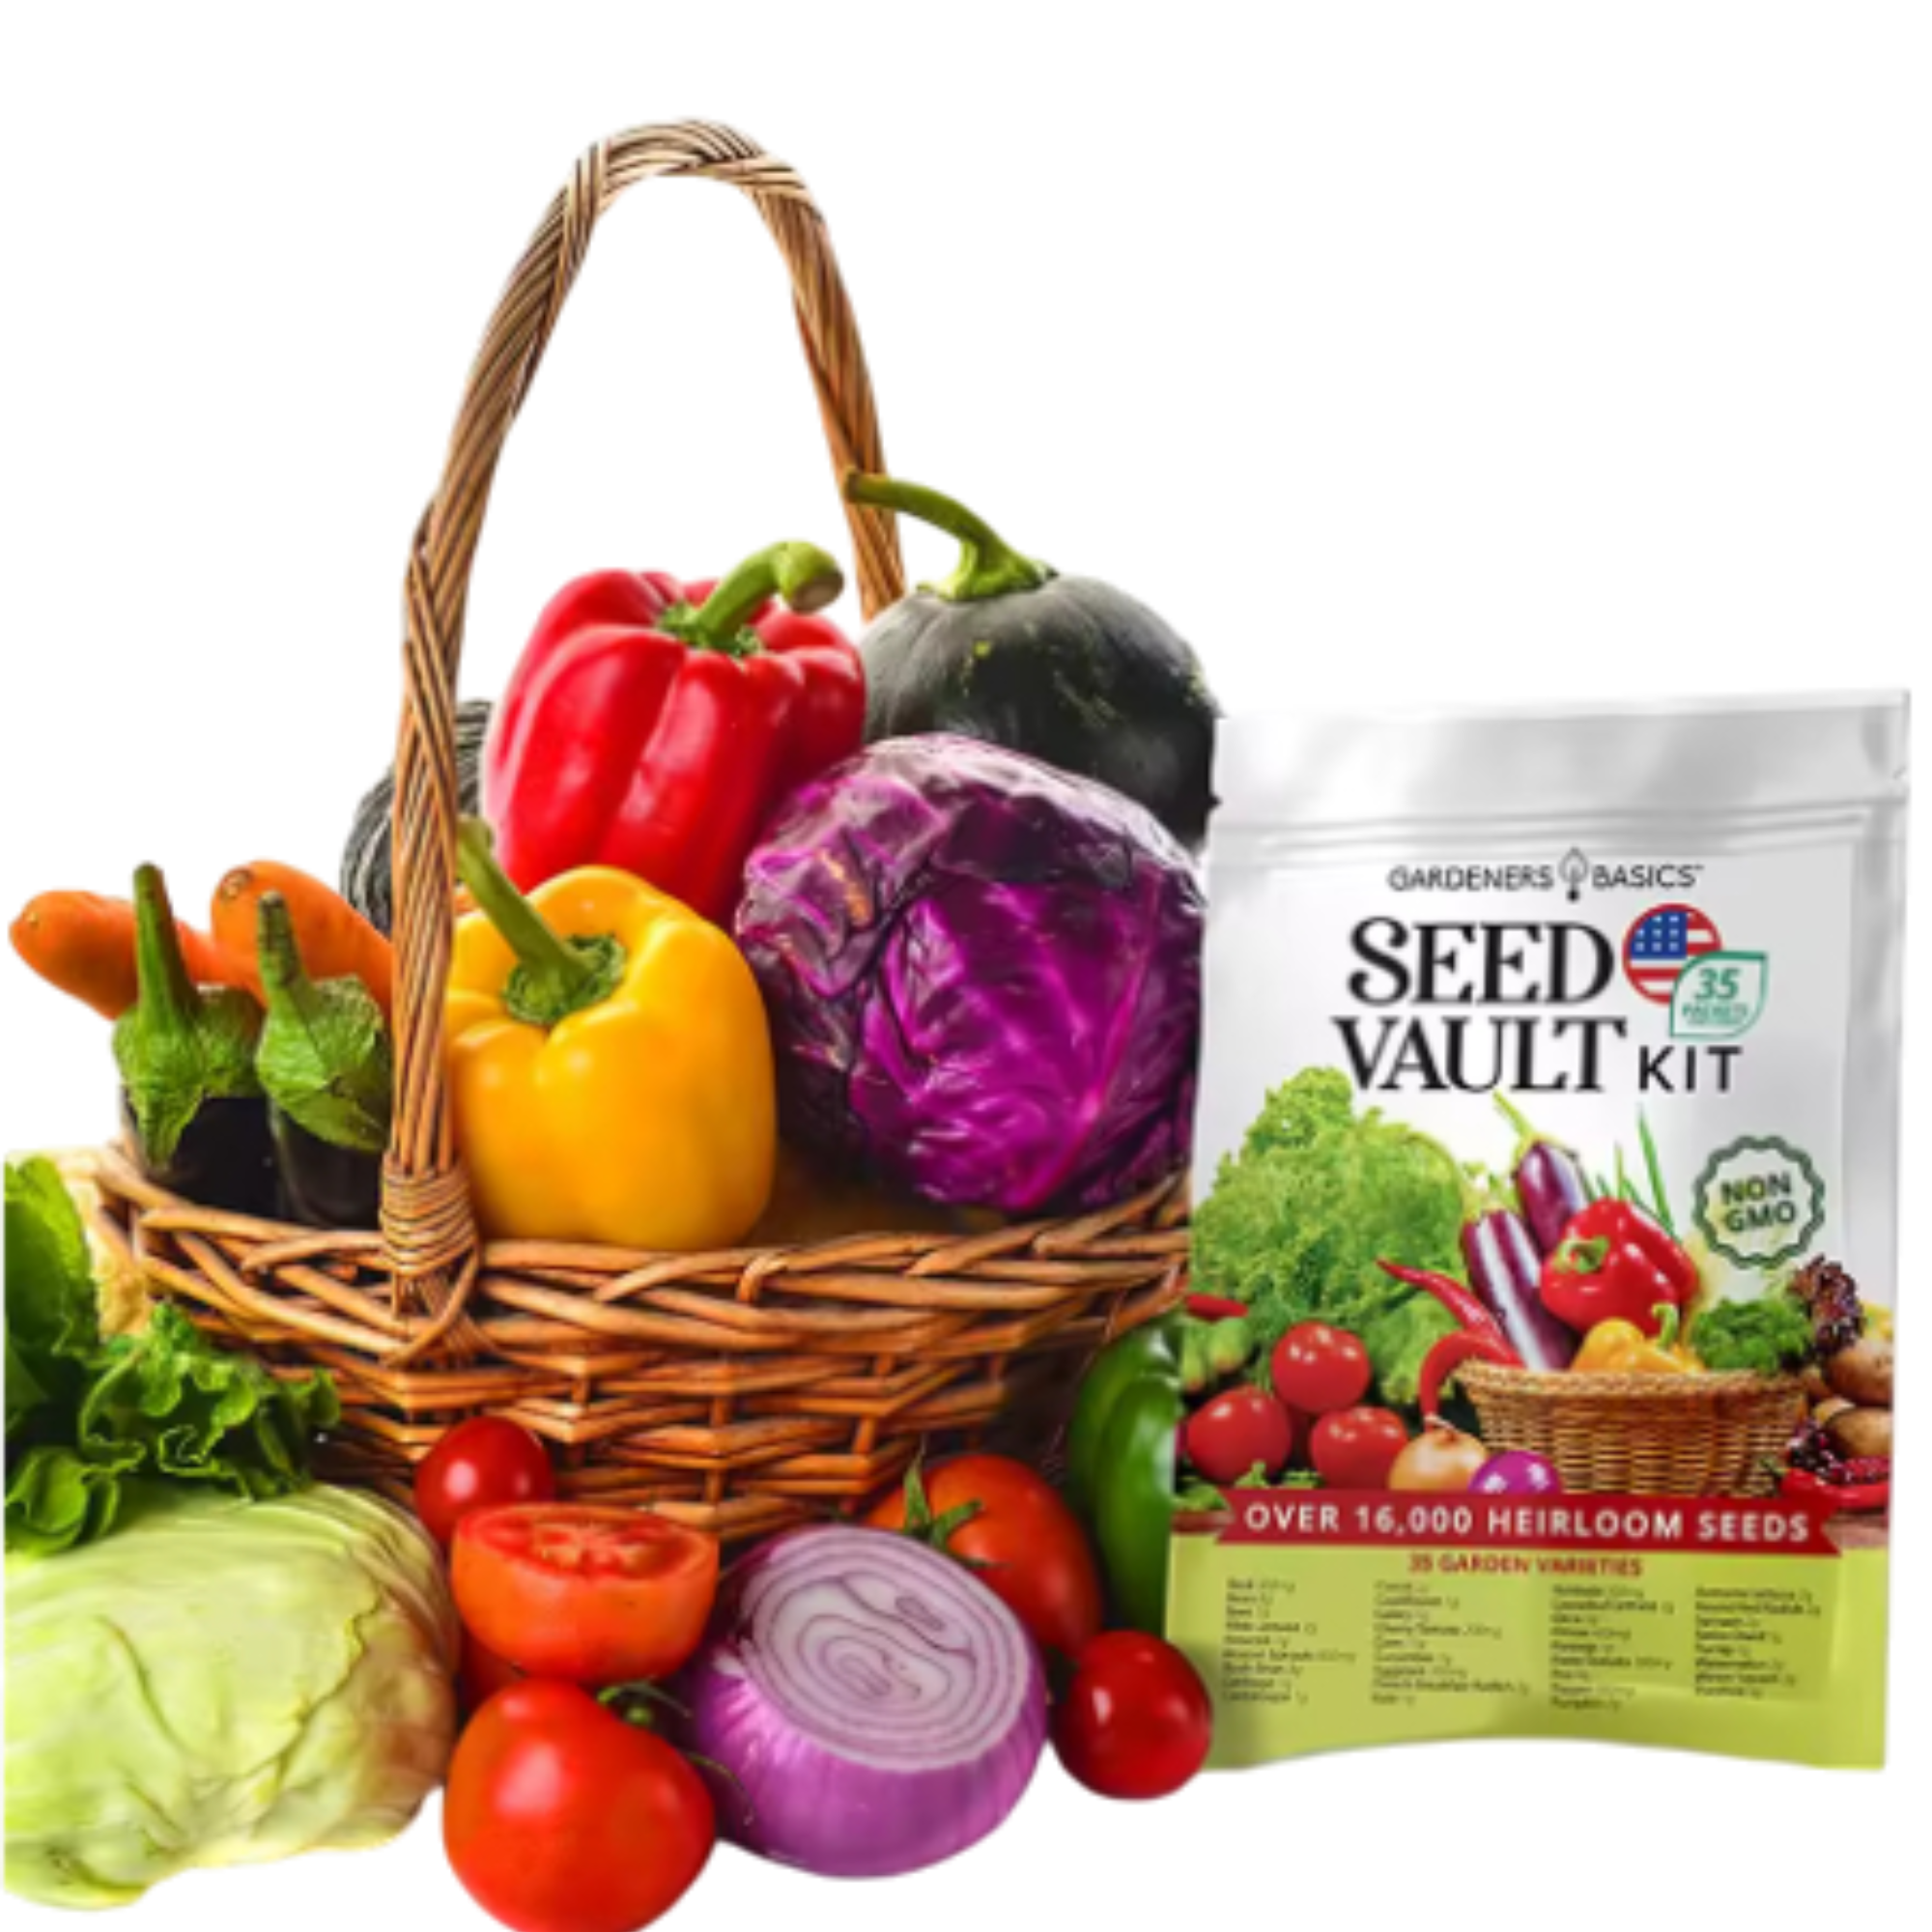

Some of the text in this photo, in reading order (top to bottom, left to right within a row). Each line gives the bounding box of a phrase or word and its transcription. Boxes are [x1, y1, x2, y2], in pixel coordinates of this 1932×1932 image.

[1388, 866, 1554, 892] GARDENERS
[1348, 917, 1615, 1007] SEED
[1694, 968, 1741, 1000] 35
[1331, 1016, 1742, 1093] VAULT KIT
[1720, 1173, 1791, 1205] NON
[1725, 1201, 1795, 1233] GMO
[1244, 1503, 1809, 1543] OVER 16,000 HEIRLOOM SEEDS
[1438, 1554, 1529, 1575] GARDEN
[1537, 1556, 1642, 1577] VARIETIES
